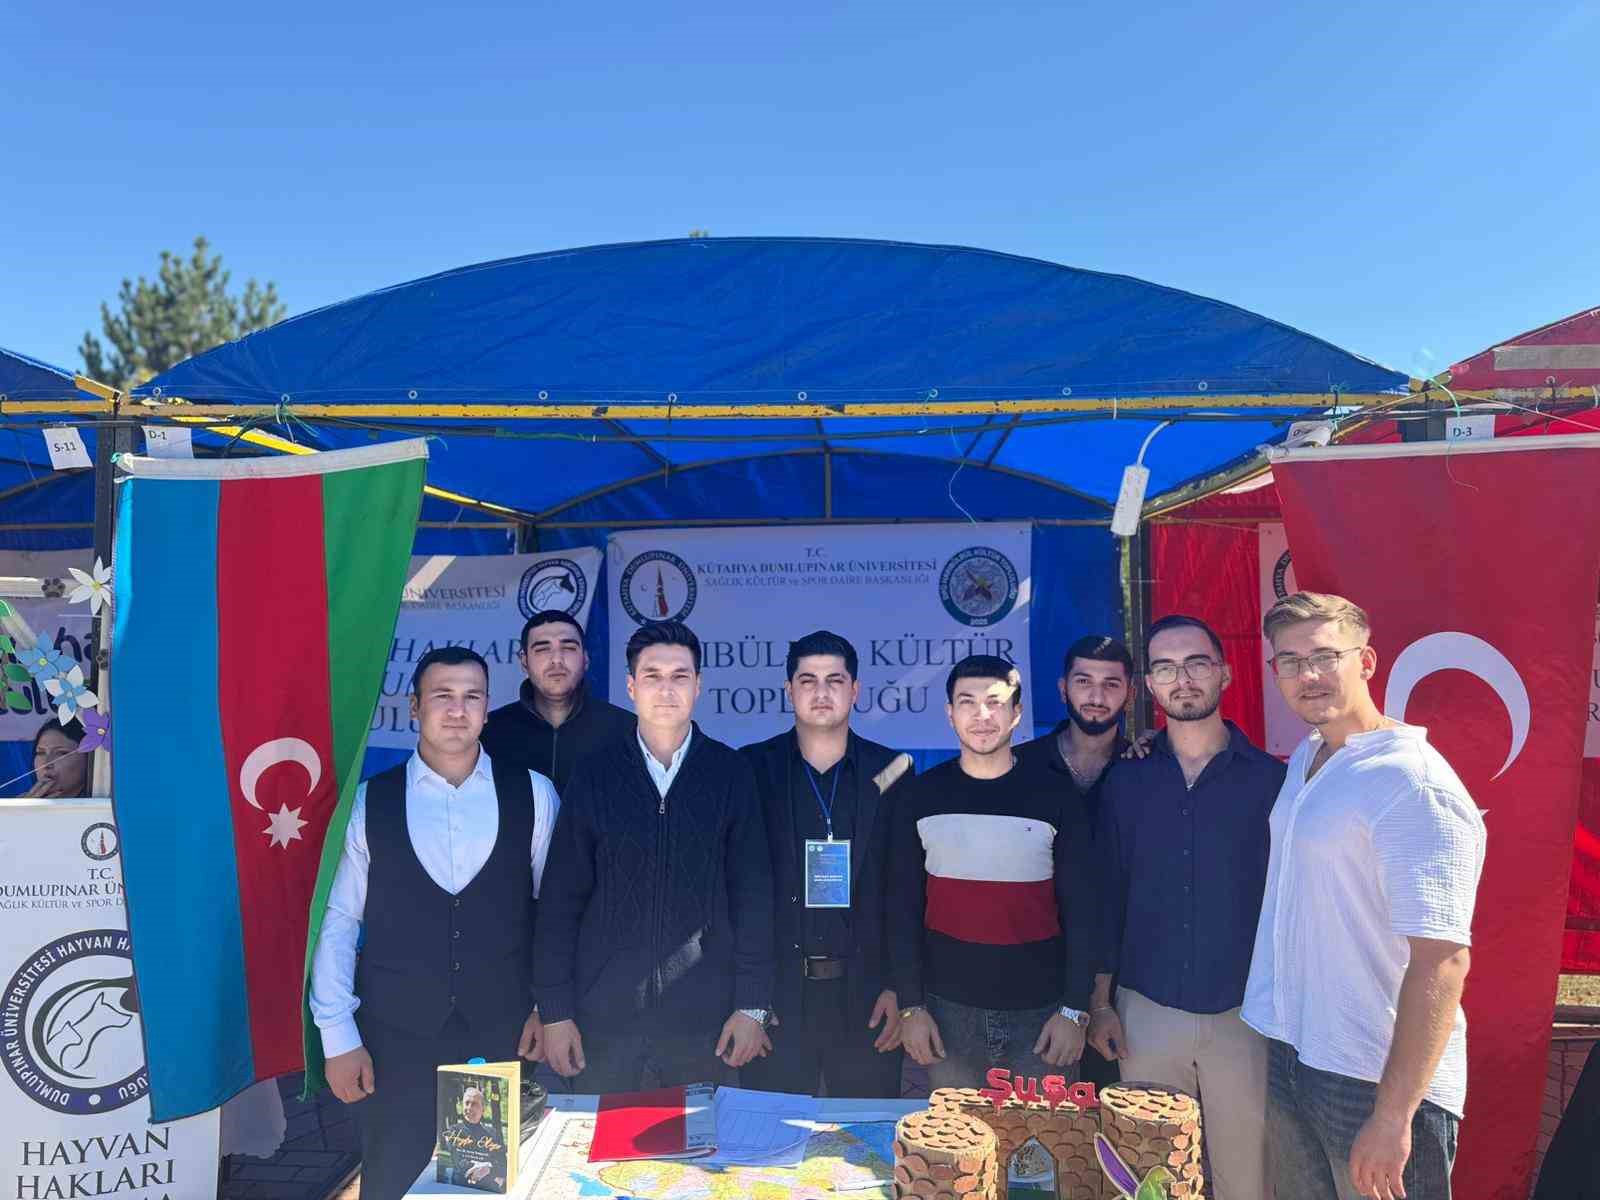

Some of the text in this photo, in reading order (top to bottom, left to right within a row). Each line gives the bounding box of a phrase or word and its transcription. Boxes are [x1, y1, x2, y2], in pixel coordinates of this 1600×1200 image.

[148, 430, 168, 441] D-1
[1452, 427, 1473, 438] D-3
[54, 442, 77, 453] S-11
[697, 560, 758, 574] KÜTAHYA
[760, 561, 846, 574] DUMLUPINAR
[869, 632, 1019, 667] KÜLTÜR
[88, 867, 115, 880] T.C.
[0, 936, 113, 1106] DUMLUPINAR ÜNİVERSİTESİ HAYVAN
[20, 1126, 173, 1167] HAYVAN
[16, 1158, 177, 1200] HAKLARI
